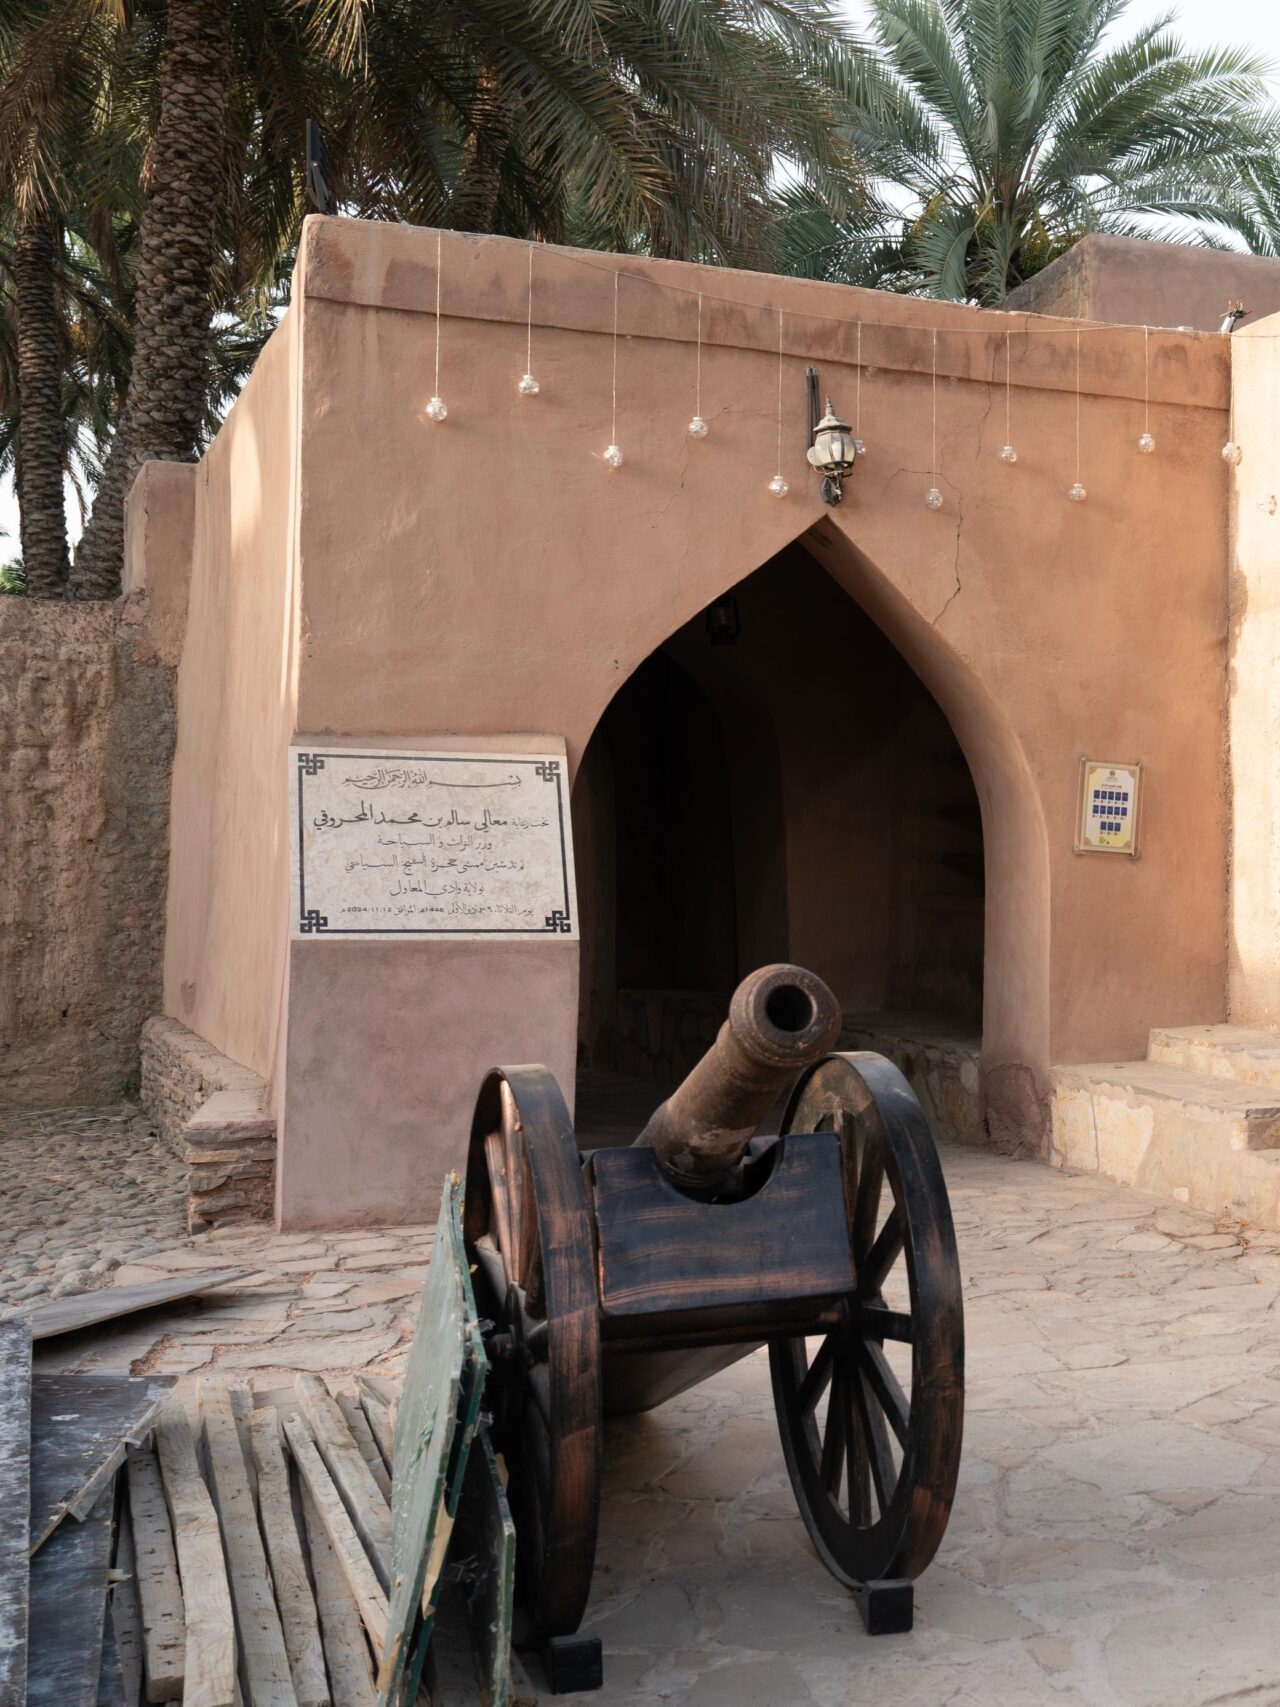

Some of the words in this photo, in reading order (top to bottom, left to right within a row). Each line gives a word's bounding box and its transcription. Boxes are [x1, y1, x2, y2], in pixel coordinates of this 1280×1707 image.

[314, 800, 374, 831] المحروقي
[374, 811, 423, 825] محمد
[421, 817, 443, 829] بن
[444, 809, 470, 827] سالم
[474, 809, 508, 832] معالي
[377, 833, 435, 849] السياحة
[431, 857, 459, 873] حجرة
[389, 879, 427, 897] المعاول
[424, 880, 462, 899] وادي
